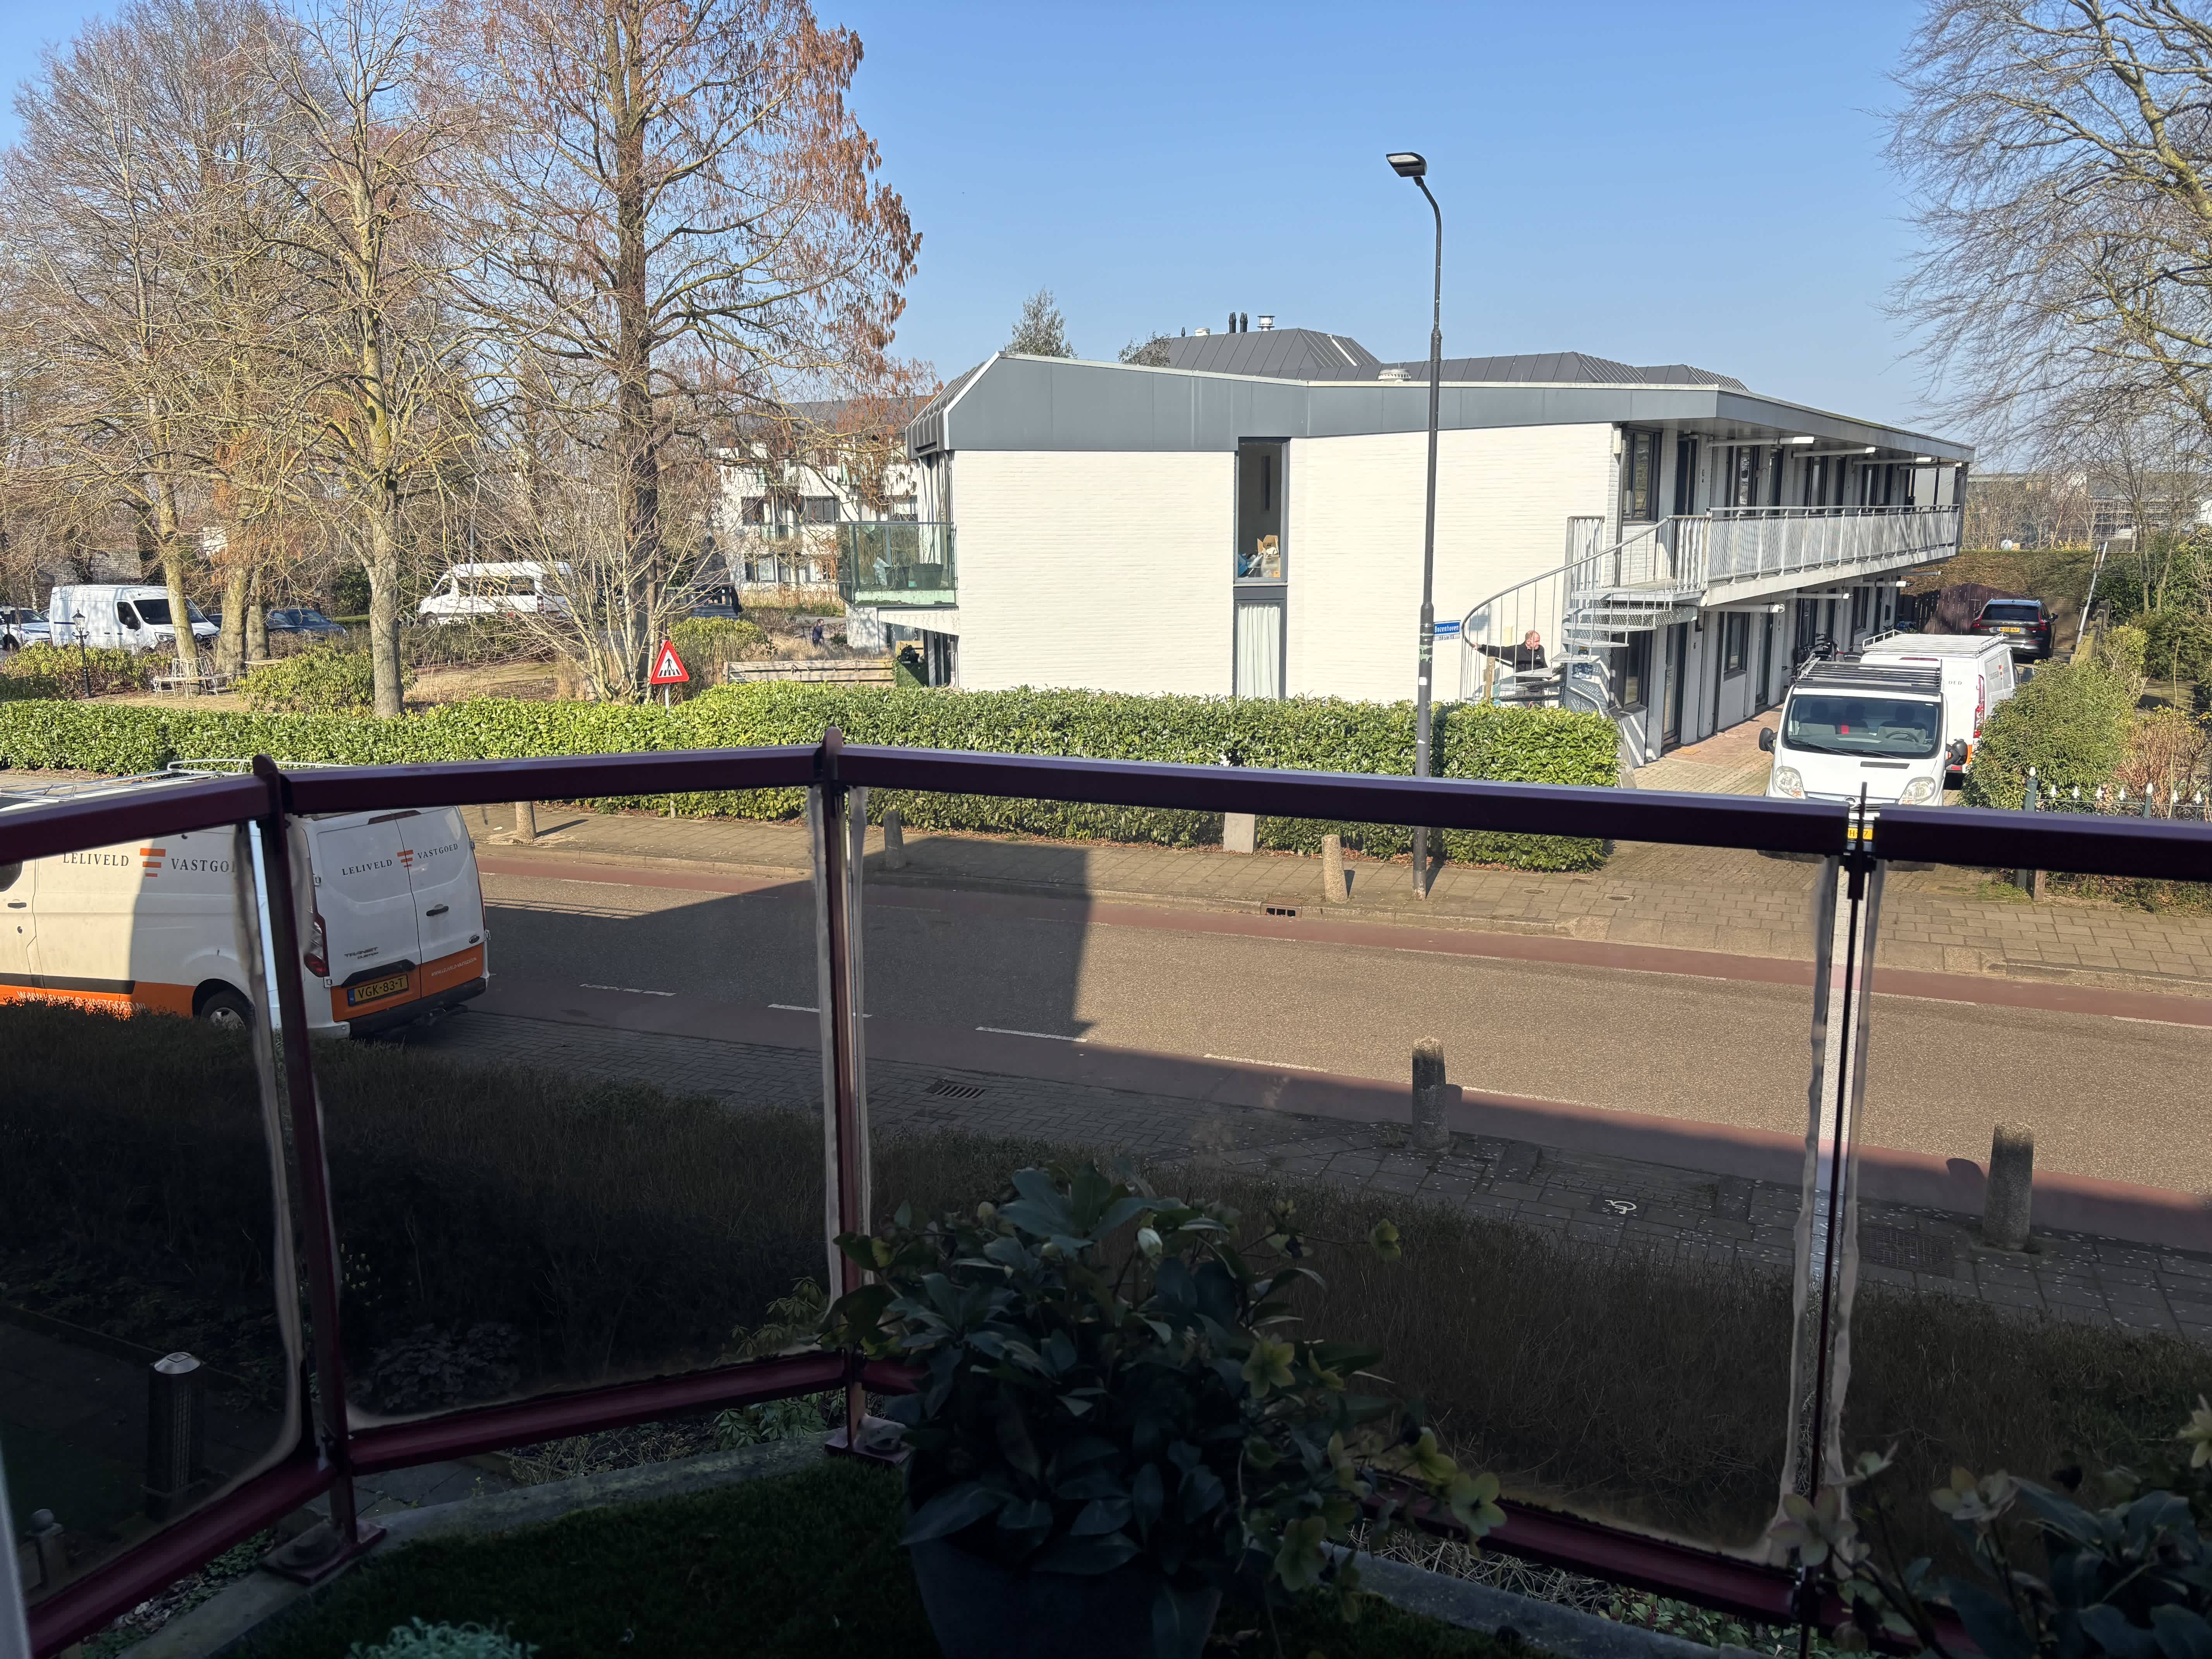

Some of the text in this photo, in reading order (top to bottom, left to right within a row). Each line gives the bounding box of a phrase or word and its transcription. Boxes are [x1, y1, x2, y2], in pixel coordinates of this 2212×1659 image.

[63, 853, 129, 866] LELIVELD
[342, 843, 458, 876] LELIVELD VASTGOED
[358, 978, 403, 998] VGK-83-T
